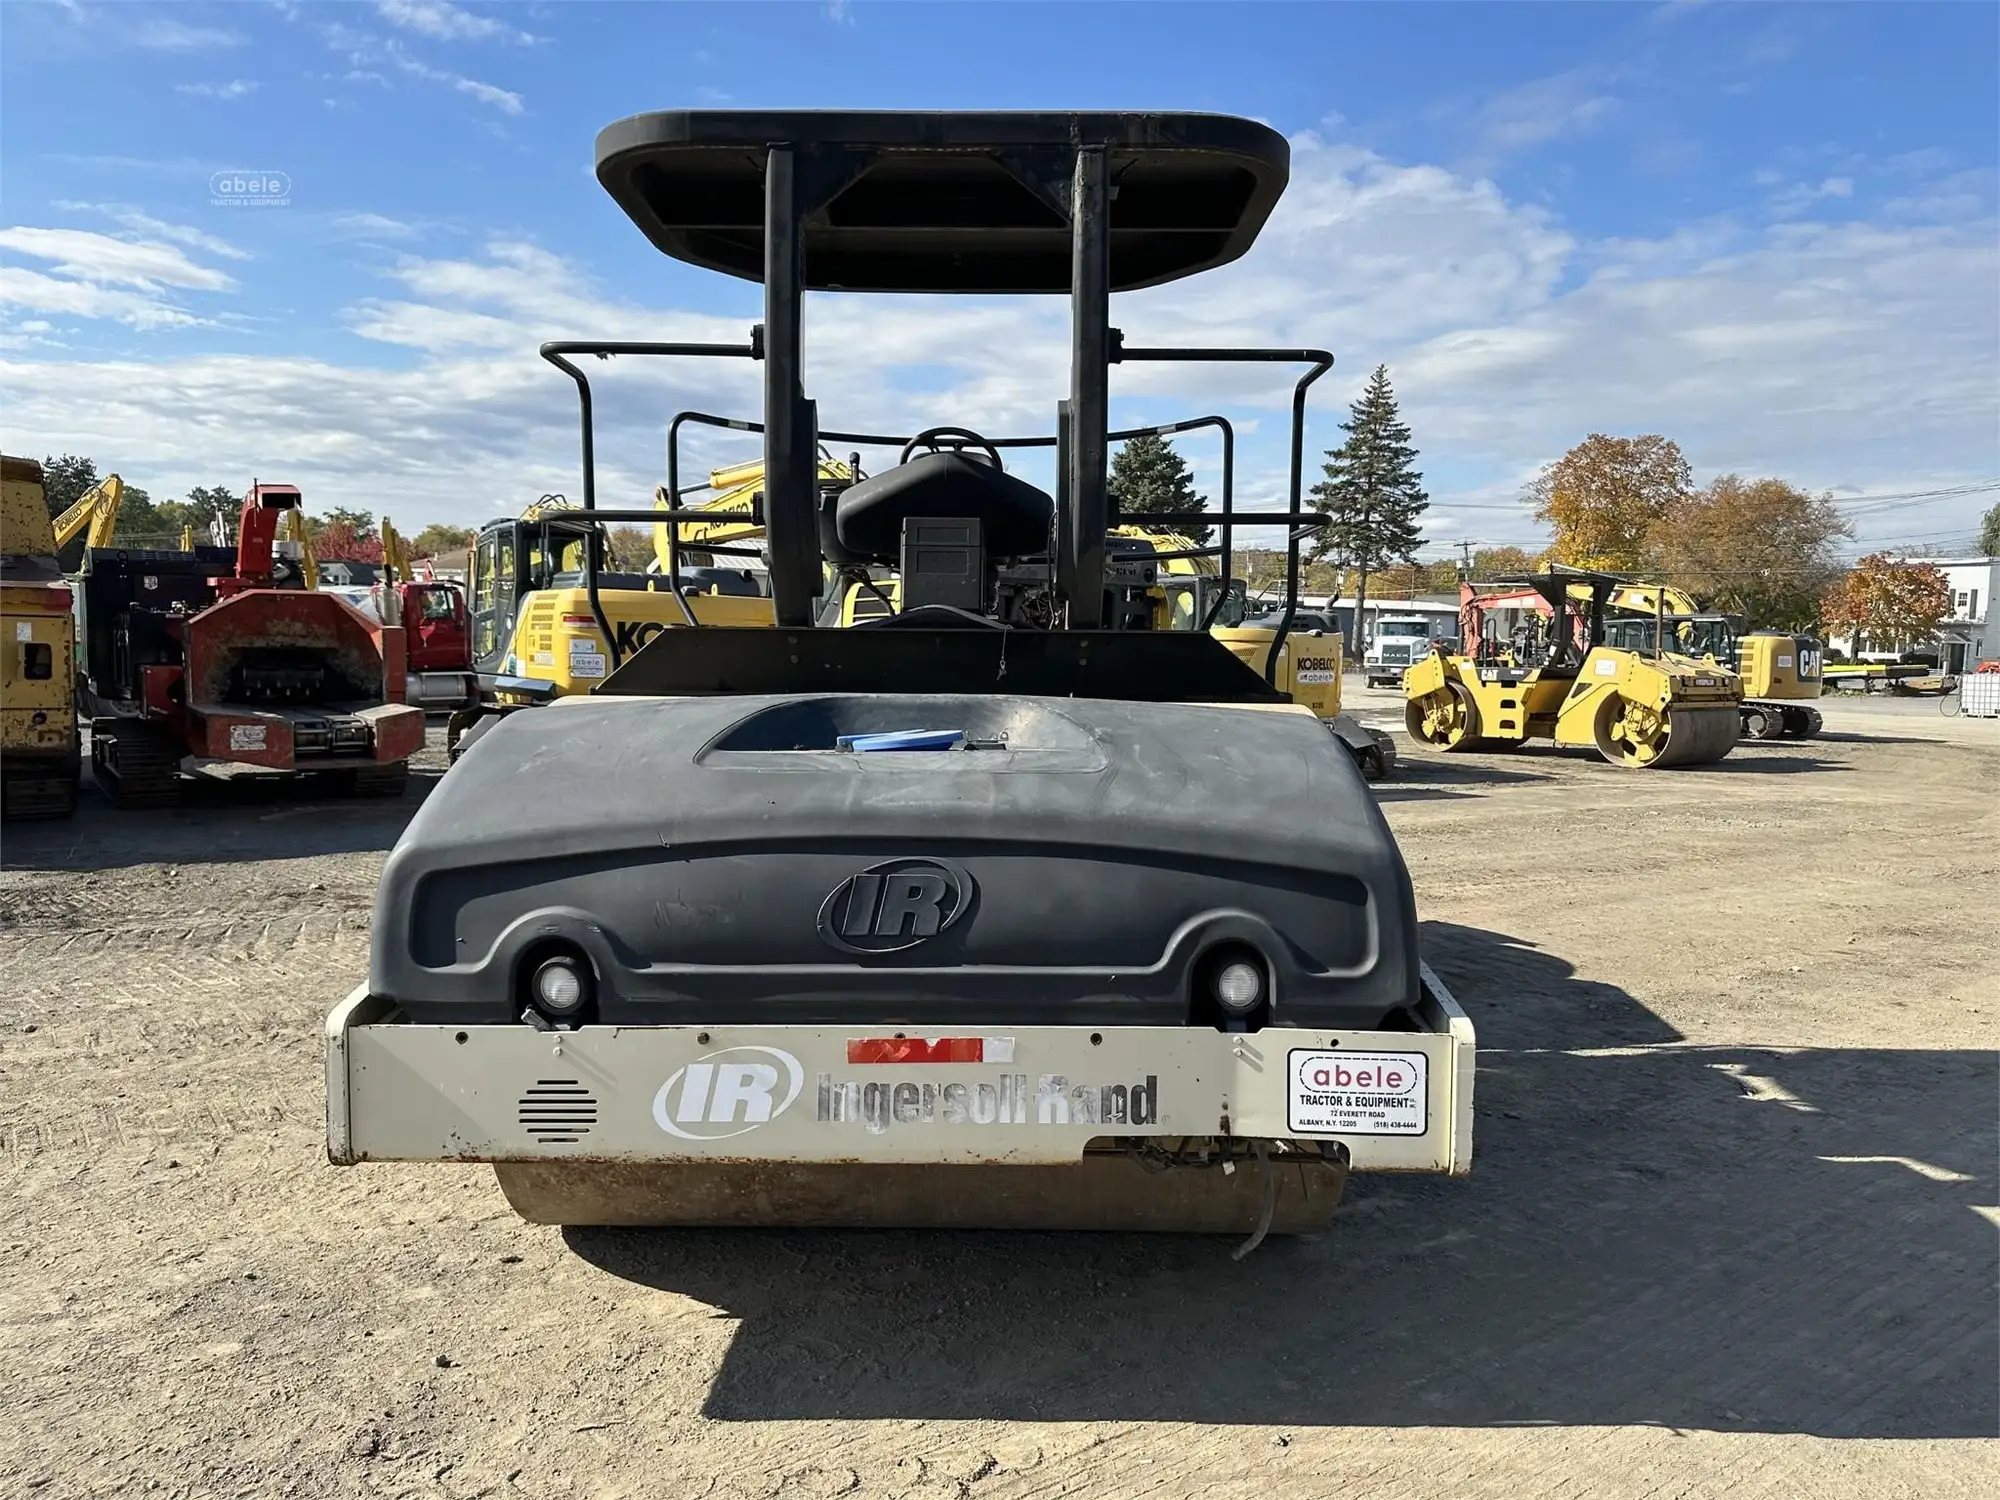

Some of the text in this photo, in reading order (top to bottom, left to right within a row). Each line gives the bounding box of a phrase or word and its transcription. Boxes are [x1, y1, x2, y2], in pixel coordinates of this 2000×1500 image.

[1297, 657, 1336, 671] KOBELCO
[1799, 649, 1821, 677] CAT
[1481, 669, 1498, 681] CAT
[841, 873, 947, 937] IR
[1313, 1064, 1403, 1089] abele
[676, 1062, 779, 1124] IR
[817, 1072, 1027, 1135] Ingersoll
[1299, 1094, 1343, 1107] TRACTOR
[1345, 1096, 1353, 1107] &
[1355, 1096, 1409, 1108] EQUIPMENT
[1330, 1109, 1338, 1117] 72
[1339, 1110, 1367, 1118] EVERETT
[1299, 1119, 1325, 1127] ALBANY,
[1373, 1121, 1390, 1129] (518)
